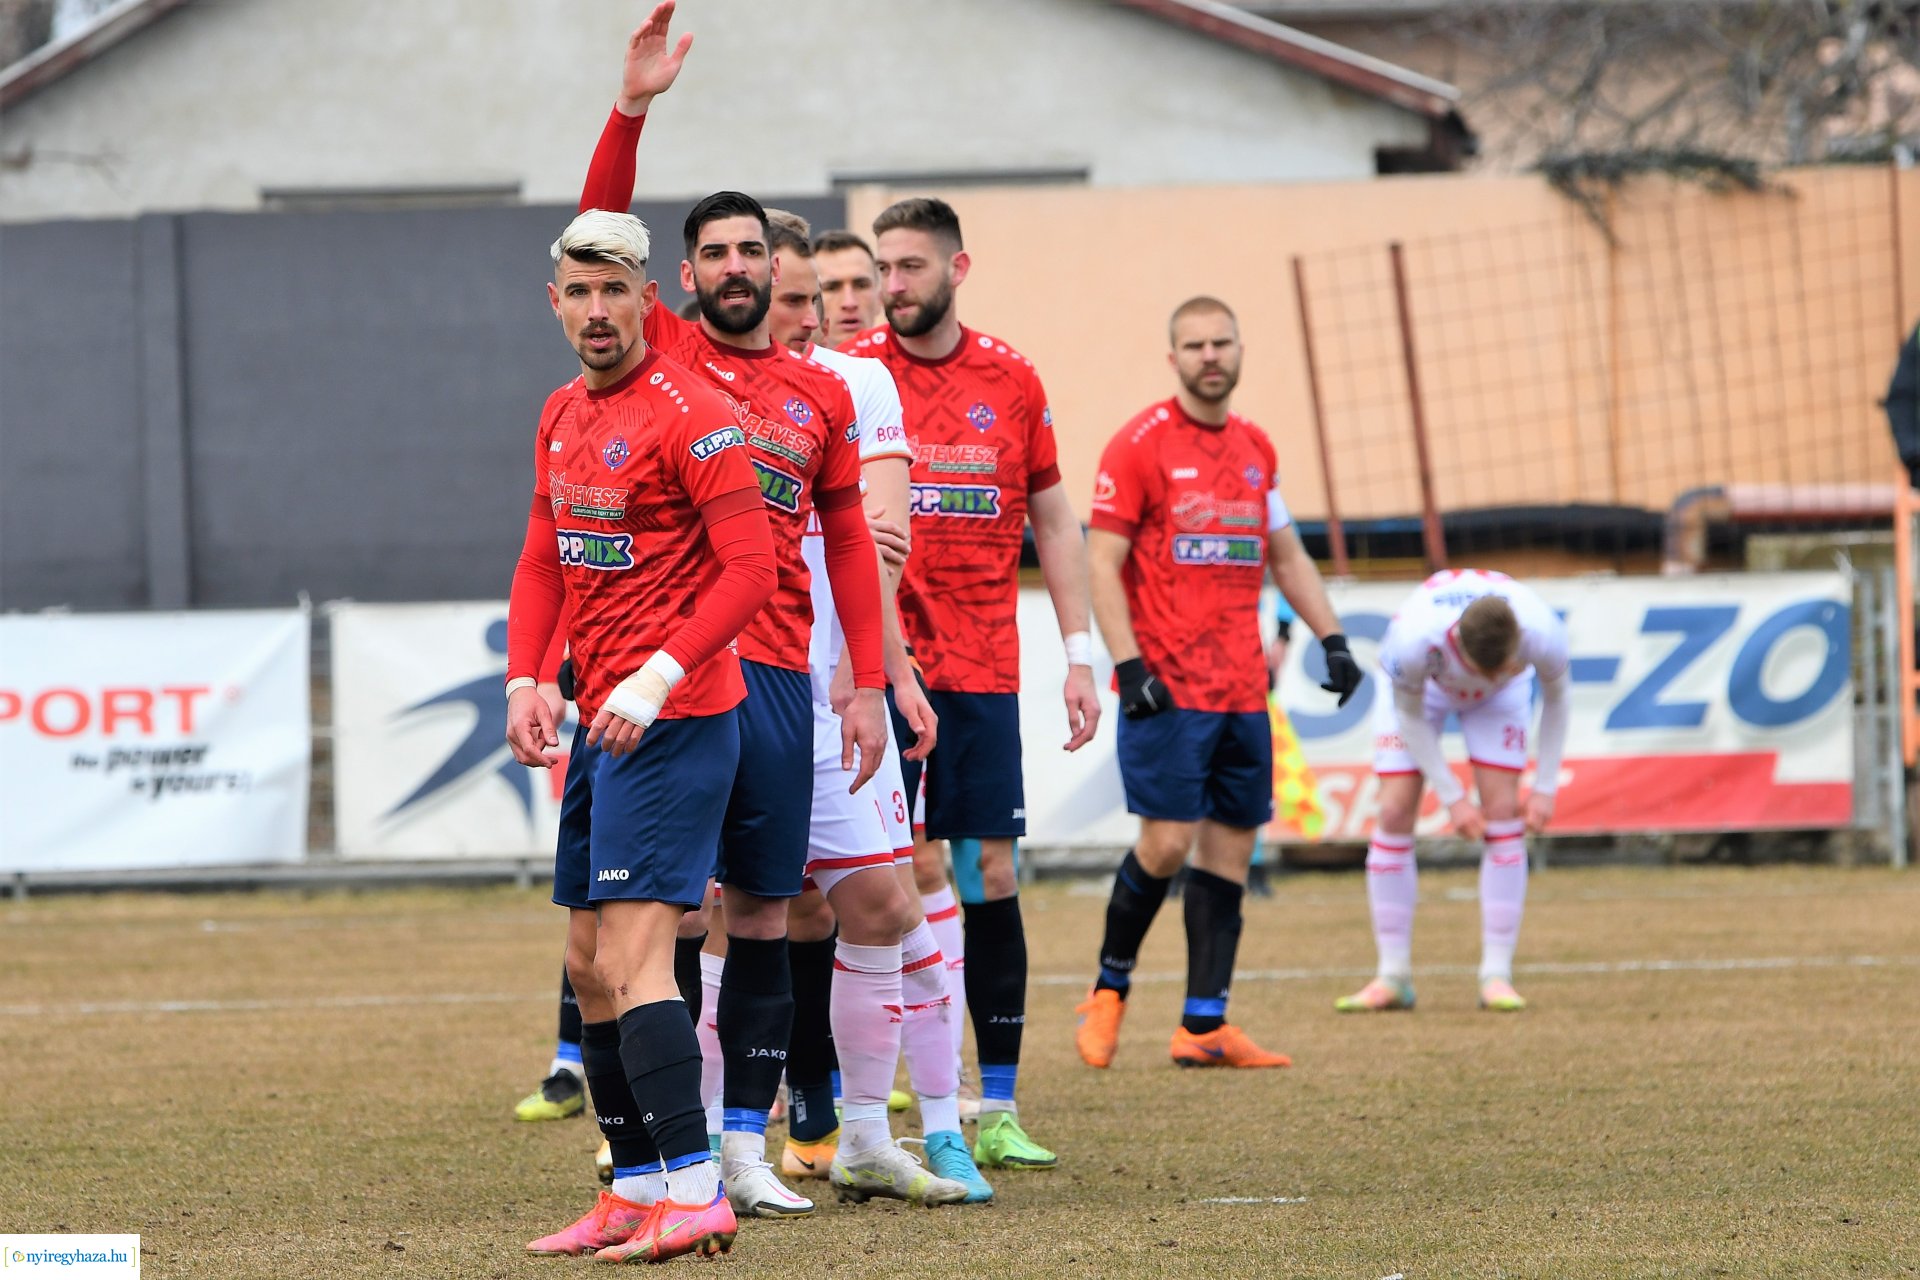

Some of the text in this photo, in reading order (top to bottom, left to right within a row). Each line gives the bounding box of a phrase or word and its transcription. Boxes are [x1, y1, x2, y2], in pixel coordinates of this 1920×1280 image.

[740, 412, 817, 458] REVESZ
[560, 484, 629, 509] REVESZ
[597, 869, 630, 882] JAKO
[747, 1048, 787, 1061] JAKO
[596, 1115, 625, 1125] AKO
